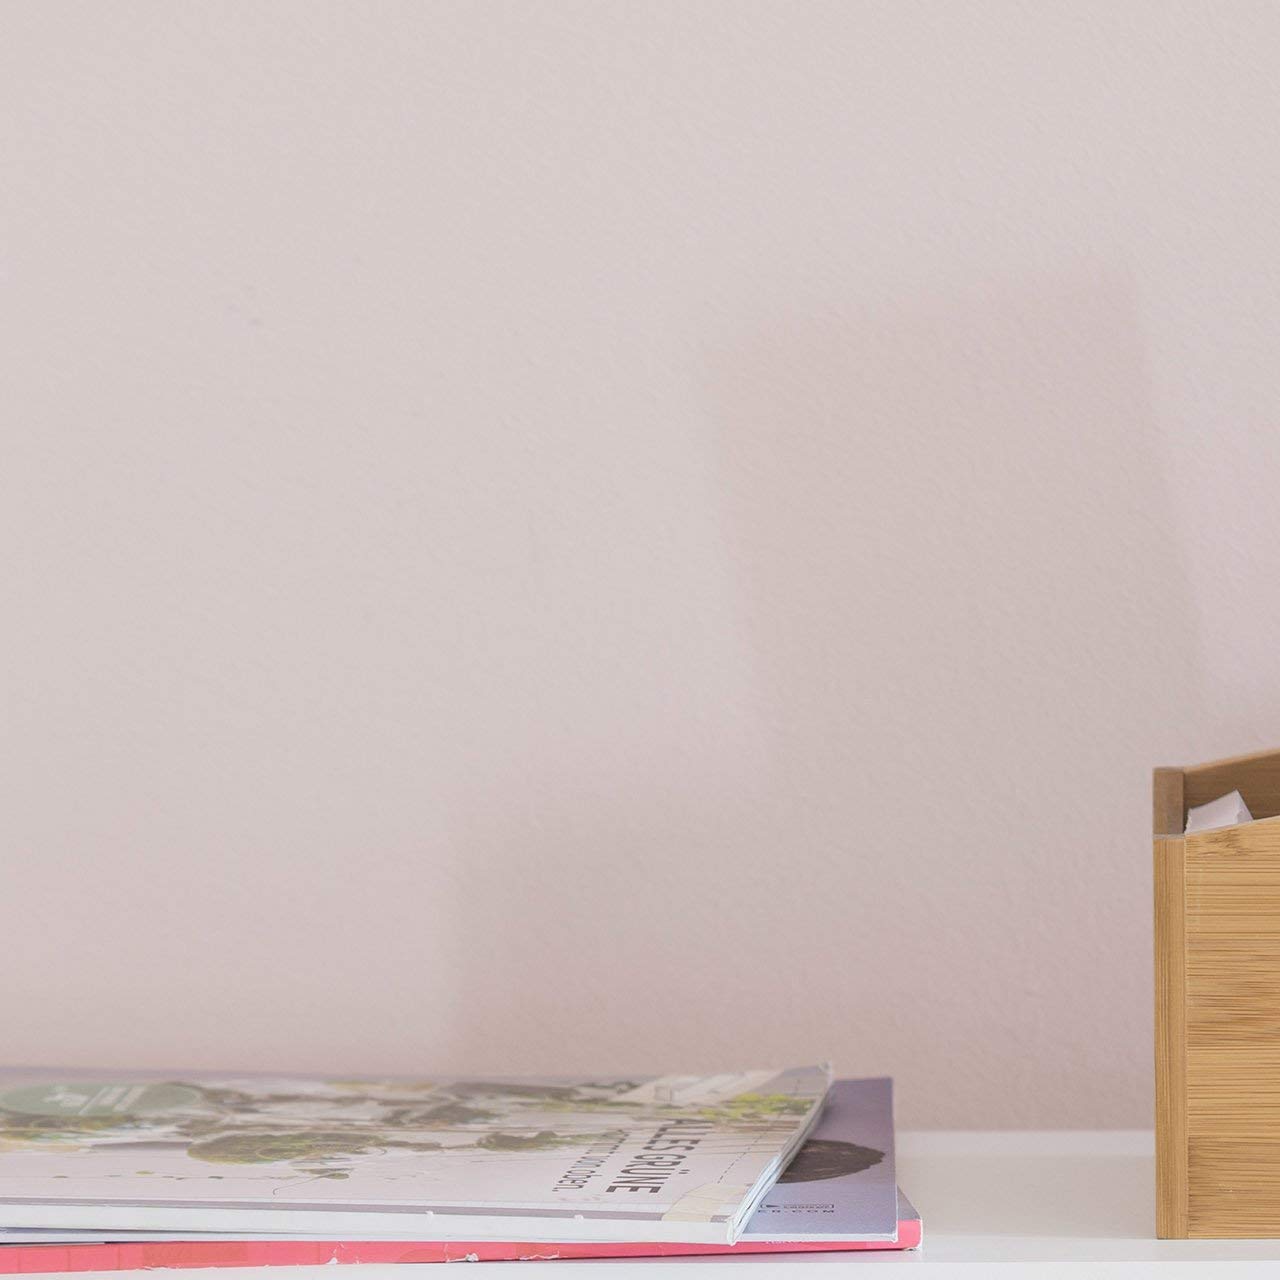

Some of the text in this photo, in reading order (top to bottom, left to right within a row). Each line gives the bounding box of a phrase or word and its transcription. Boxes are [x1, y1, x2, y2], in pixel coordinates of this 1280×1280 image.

[551, 1169, 602, 1192] oben.
[605, 1117, 712, 1194] ALLES GRÜNE
